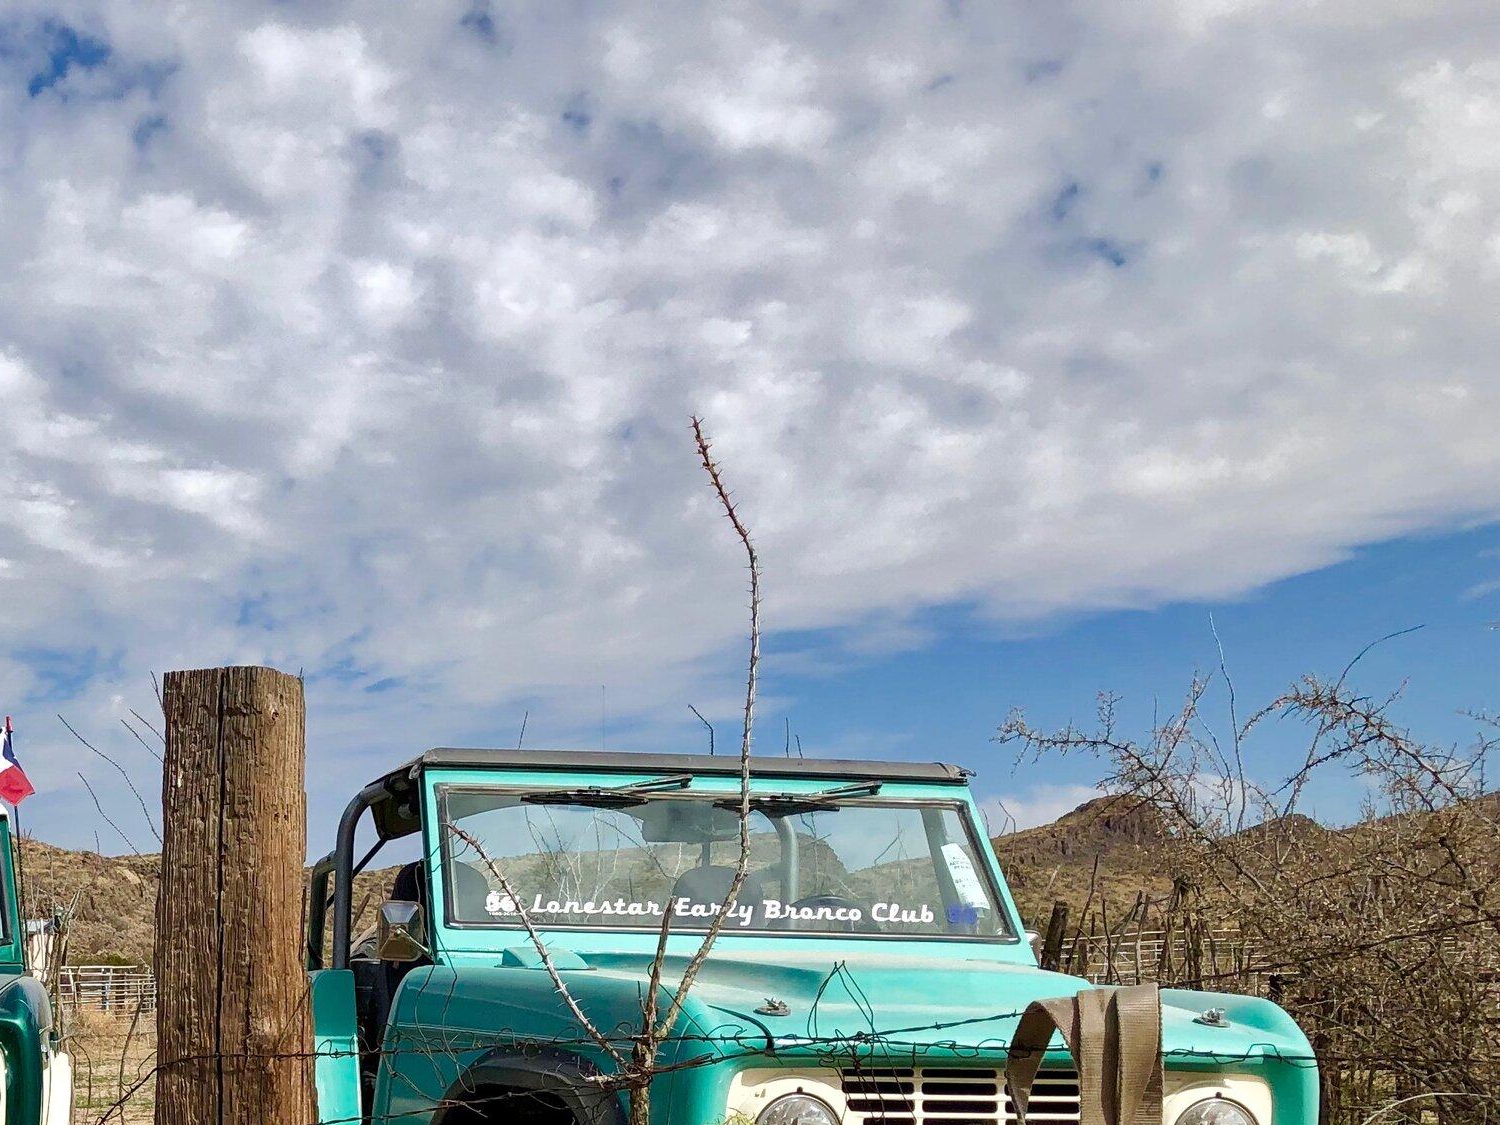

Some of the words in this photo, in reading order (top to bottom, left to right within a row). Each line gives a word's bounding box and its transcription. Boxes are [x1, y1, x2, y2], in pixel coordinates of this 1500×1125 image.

[531, 894, 664, 916] Lonestar
[674, 897, 754, 927] Early
[763, 899, 862, 922] Bronco
[871, 903, 934, 923] Club
